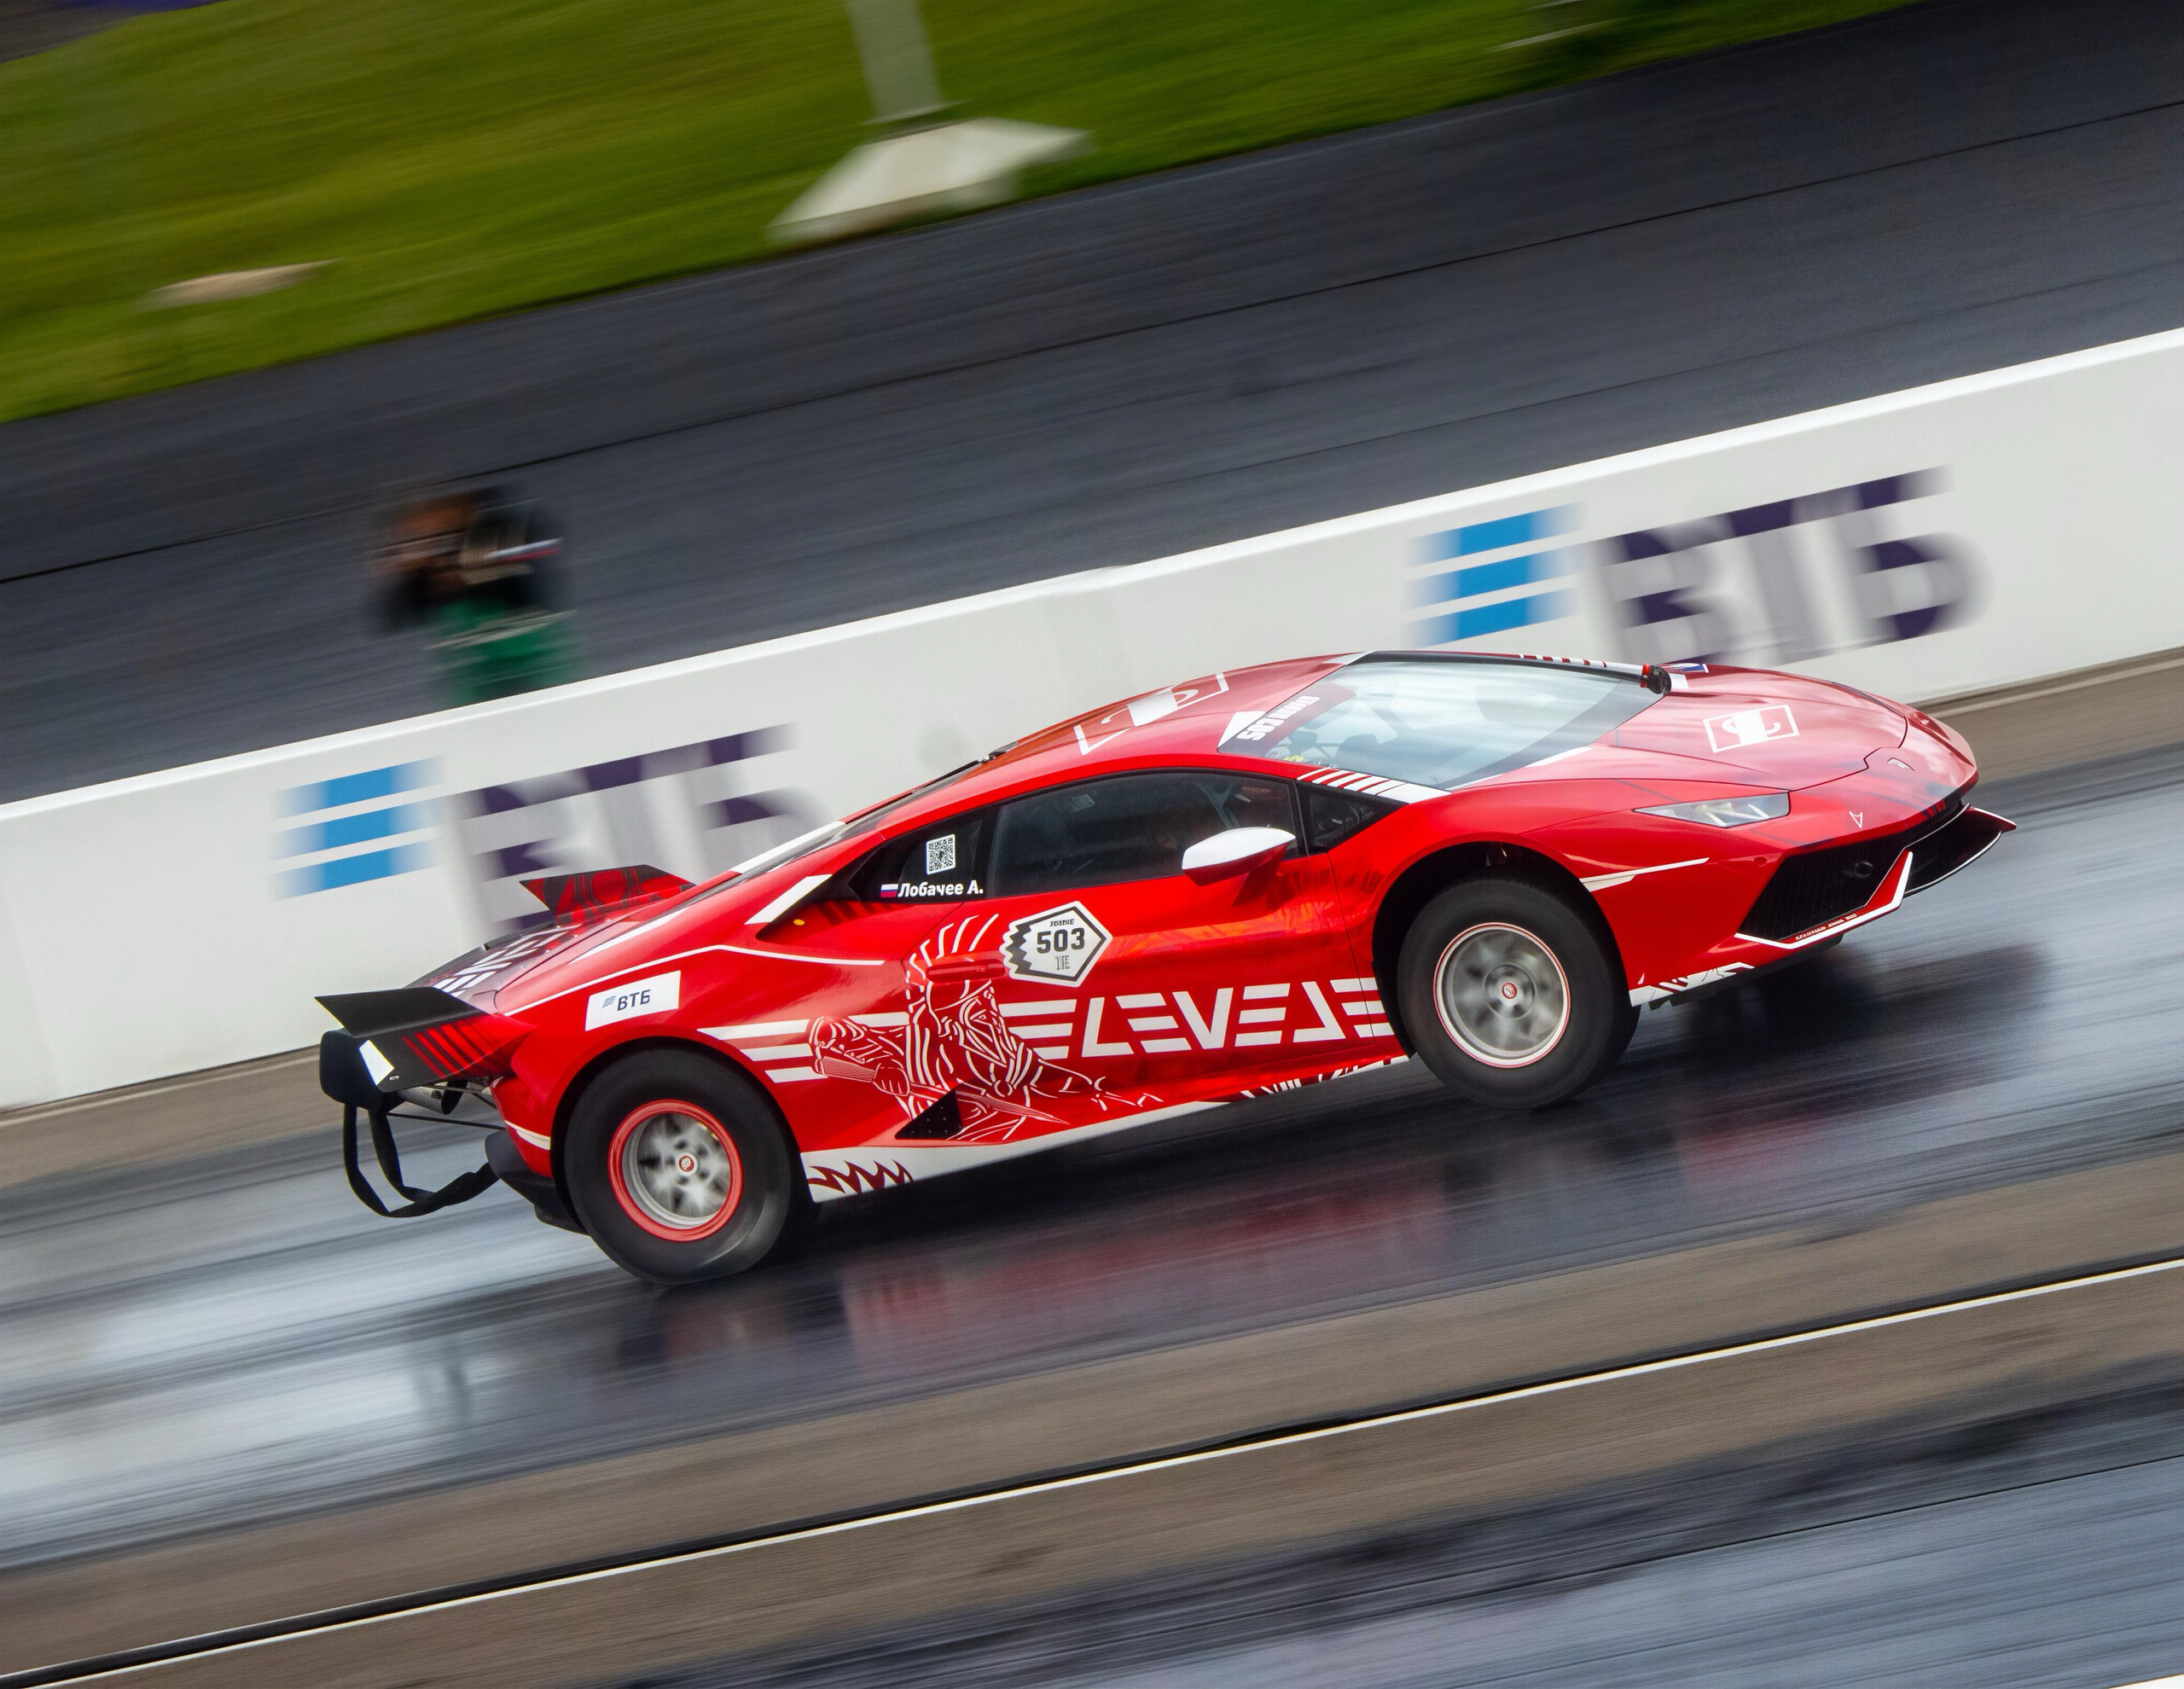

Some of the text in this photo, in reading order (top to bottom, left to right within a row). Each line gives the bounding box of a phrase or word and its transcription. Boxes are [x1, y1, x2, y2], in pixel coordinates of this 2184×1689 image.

[967, 879, 984, 895] А.
[1037, 927, 1084, 954] 503
[617, 989, 651, 1012] ВТБ
